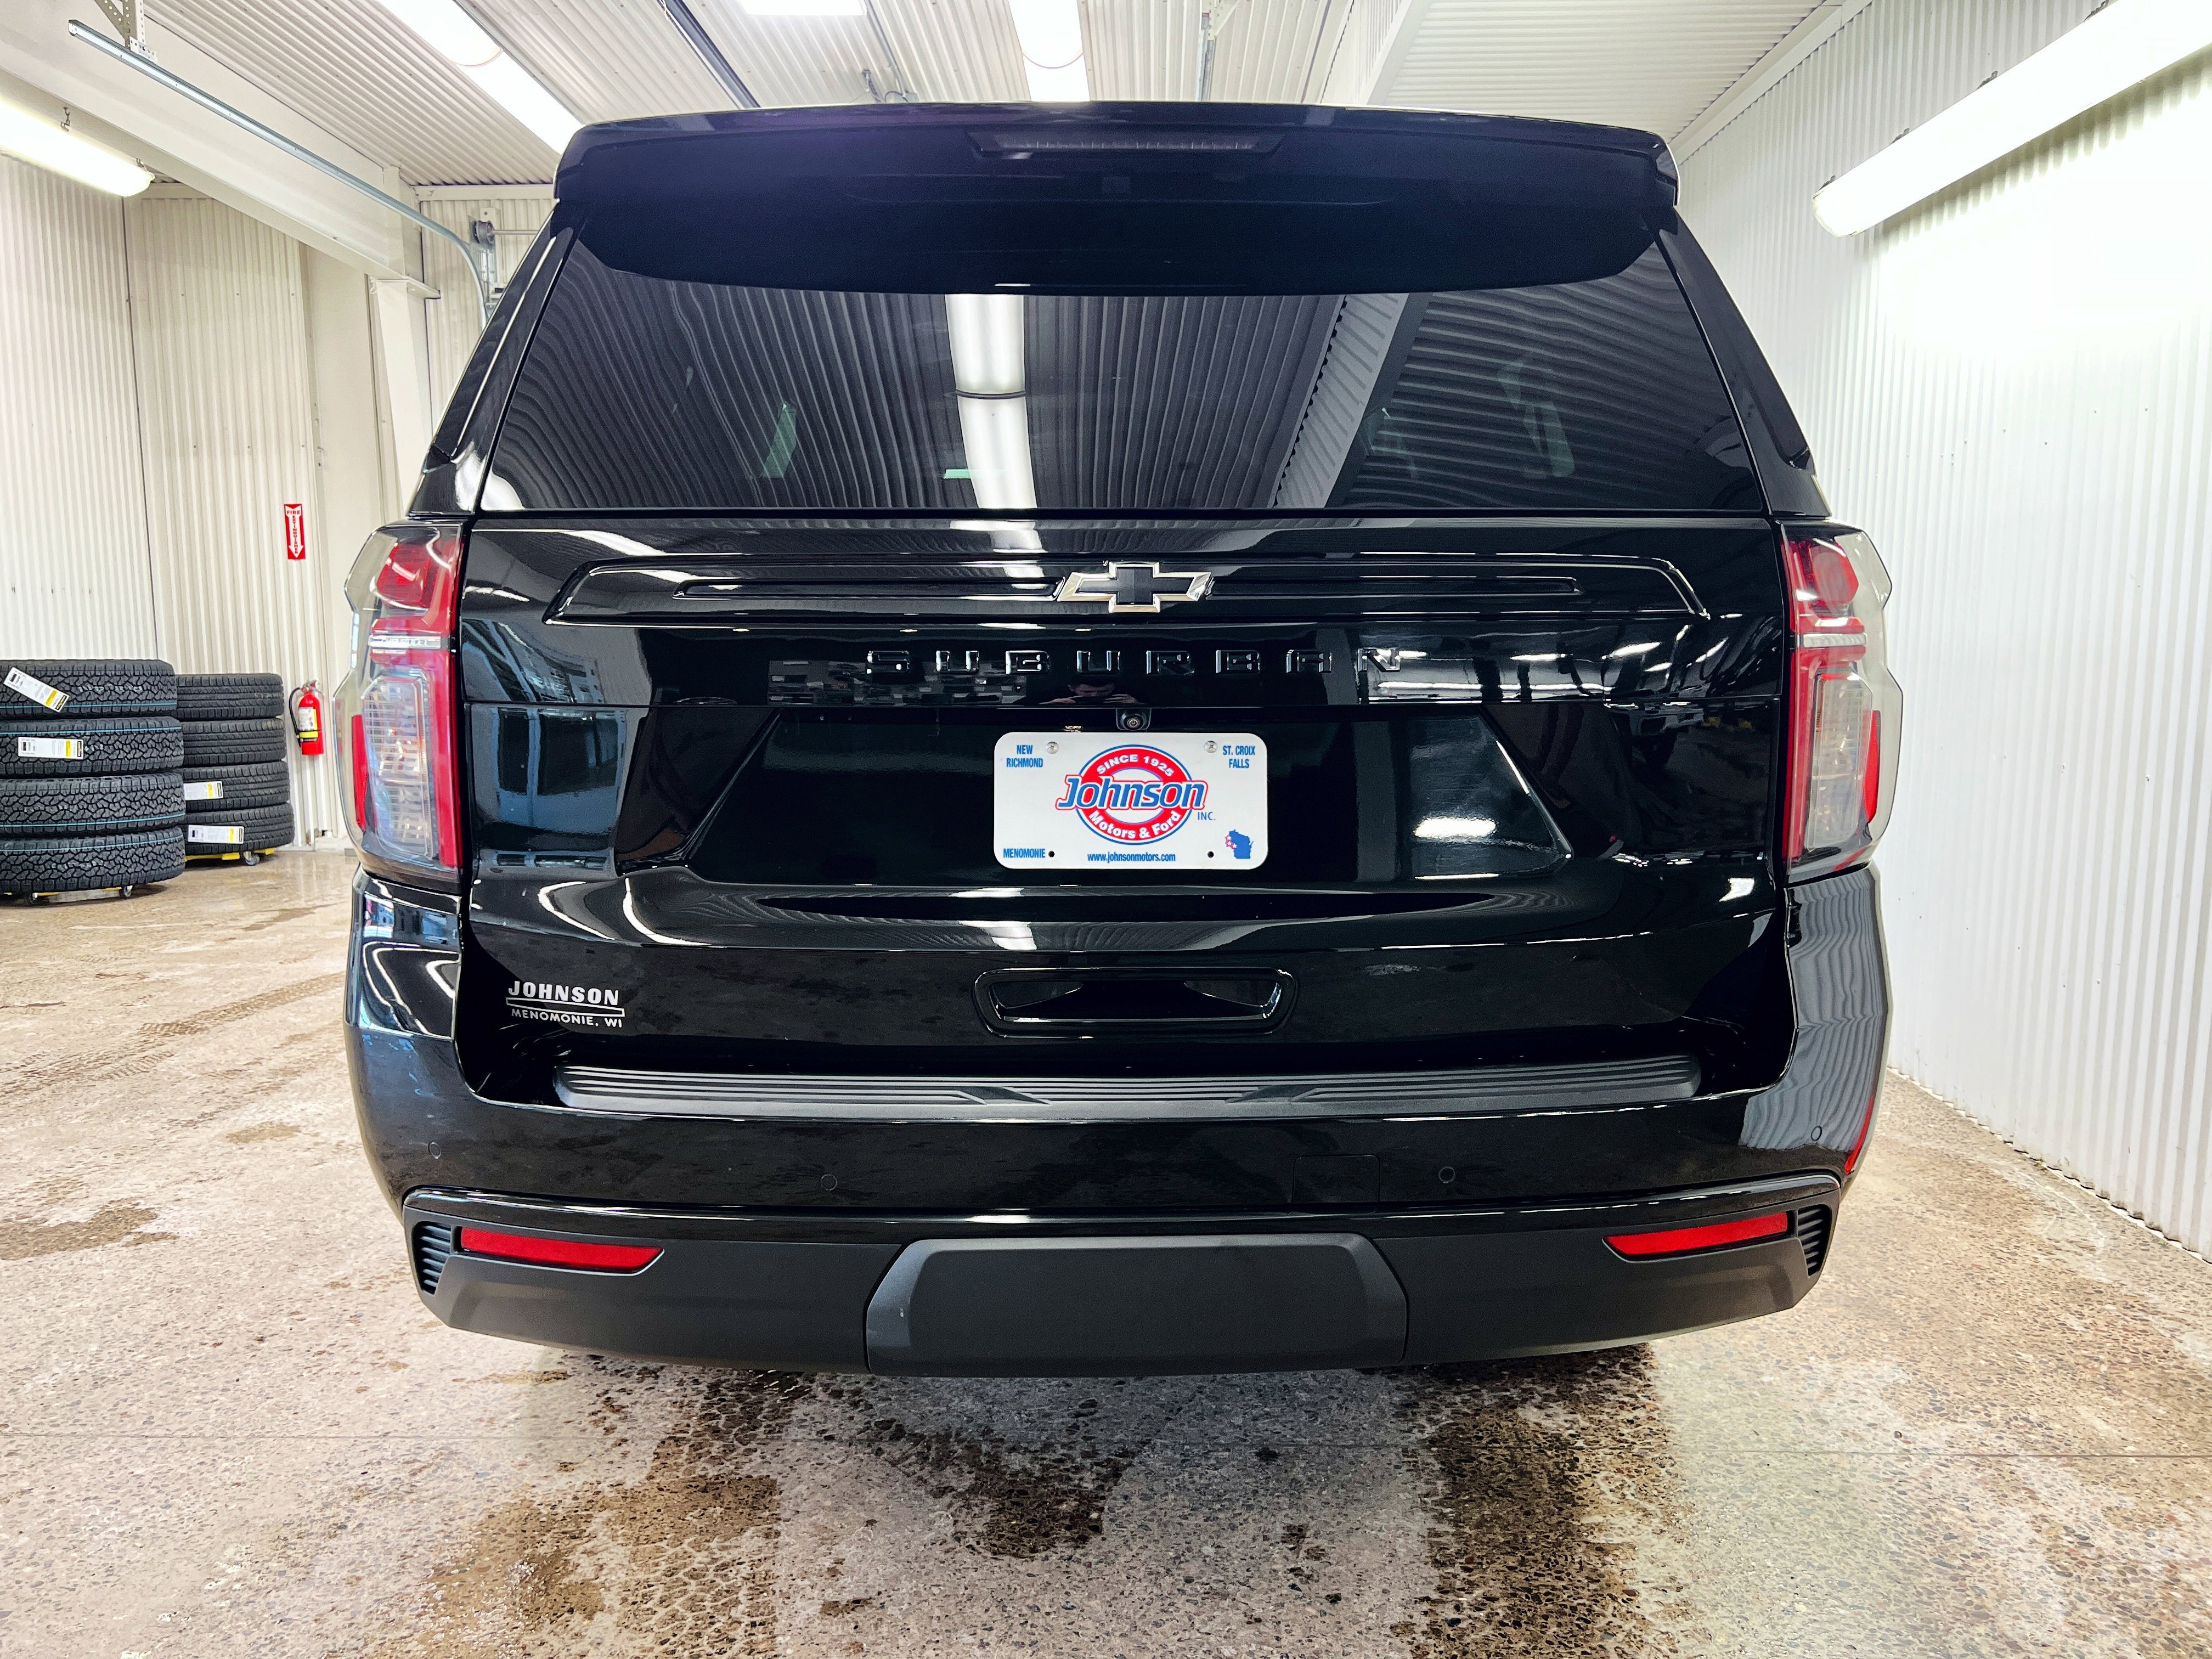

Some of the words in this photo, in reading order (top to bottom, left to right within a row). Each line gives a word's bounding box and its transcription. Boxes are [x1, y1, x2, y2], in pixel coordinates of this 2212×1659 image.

[866, 648, 1401, 675] SUBURBAN
[1017, 744, 1033, 754] NEW
[1222, 745, 1233, 755] ST.
[1235, 745, 1256, 755] CROIX
[1006, 758, 1043, 768] RICHMOND
[1096, 754, 1138, 774] SINCE
[1143, 756, 1175, 777] 1925
[1229, 758, 1250, 769] FALLS
[1056, 776, 1206, 809] Johnson
[1197, 811, 1216, 821] INC.
[1088, 811, 1136, 839] Motors
[1139, 827, 1150, 839] &
[1152, 810, 1181, 836] Ford
[1003, 848, 1046, 859] MENOMONIE
[1087, 851, 1176, 864] www.johnsonmotors.com
[508, 981, 619, 1006] JOHNSON
[511, 1008, 599, 1026] MENOMONIE,
[604, 1018, 622, 1028] WI
